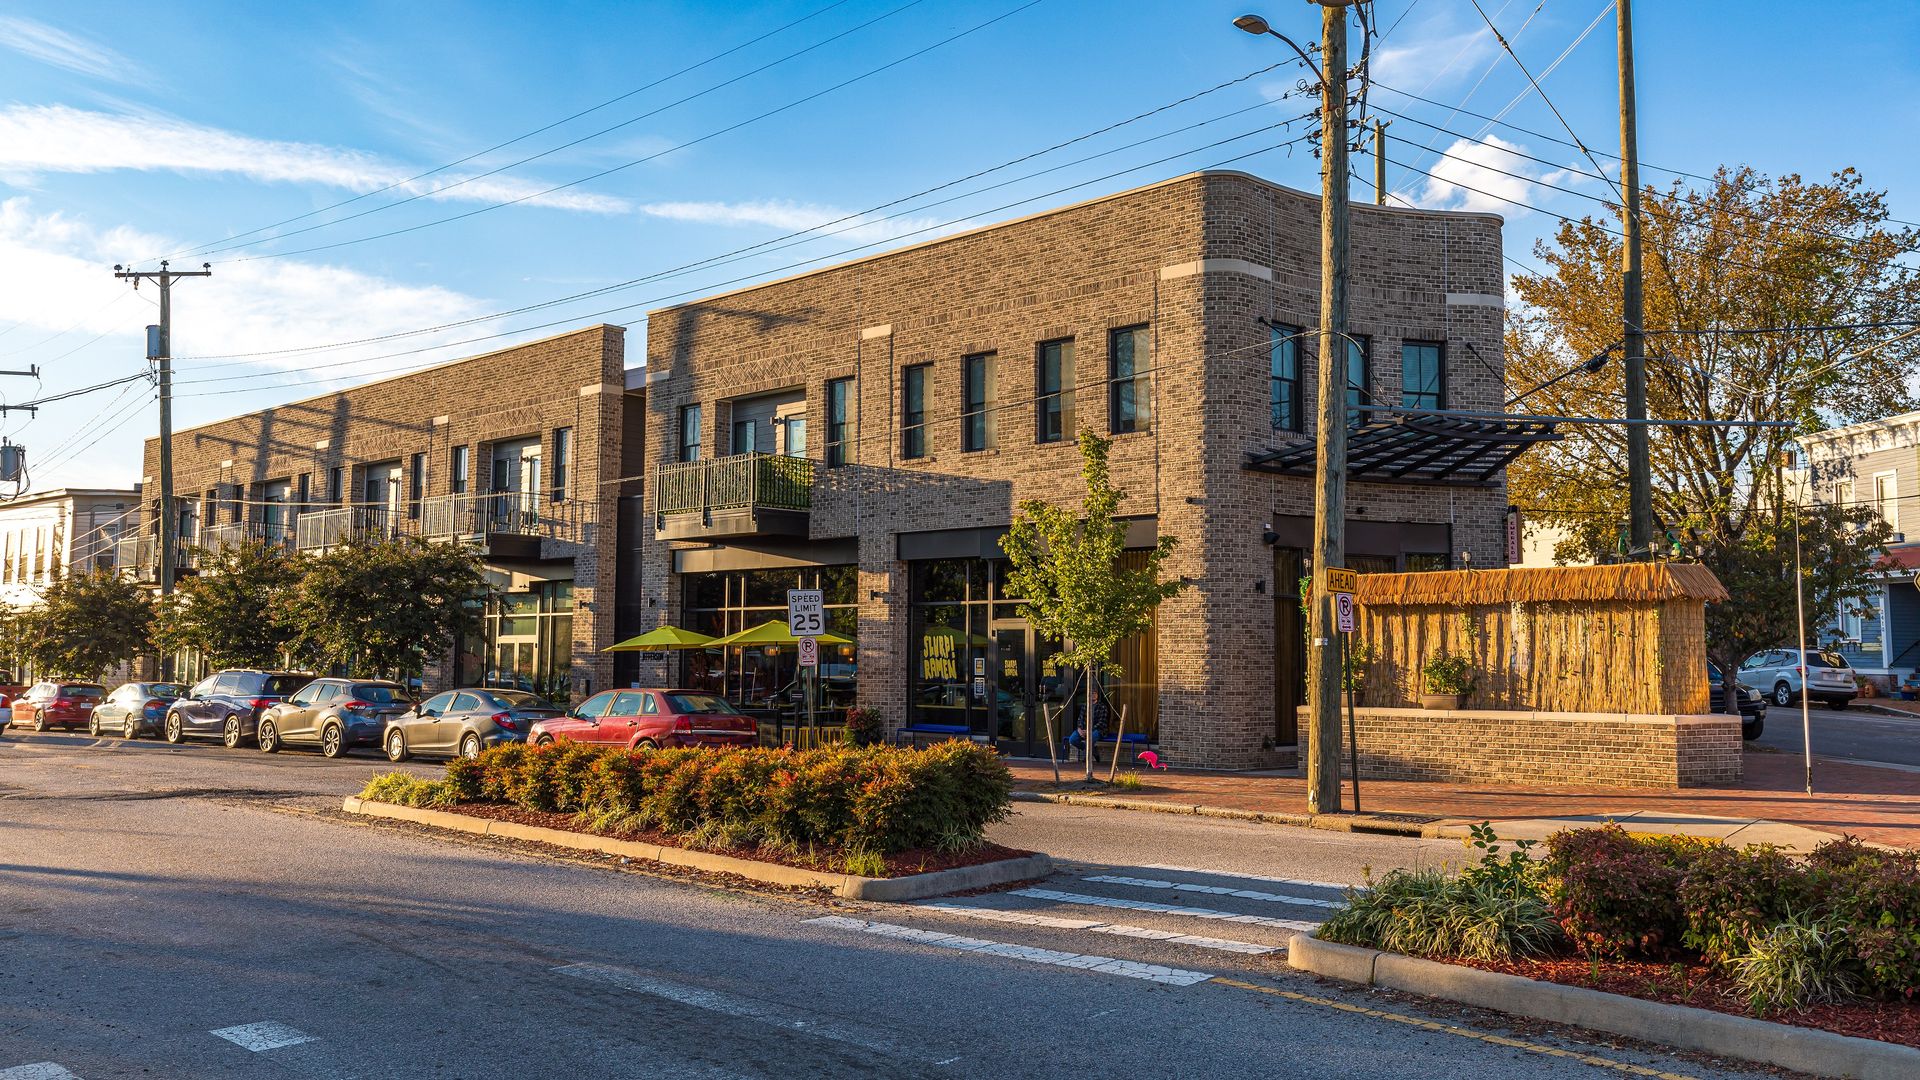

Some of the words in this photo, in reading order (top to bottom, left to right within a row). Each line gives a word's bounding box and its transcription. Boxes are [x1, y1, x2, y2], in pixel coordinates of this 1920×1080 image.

[1329, 573, 1355, 590] AHEAD
[791, 595, 820, 603] SPEED
[795, 604, 817, 613] LIMIT
[793, 614, 820, 631] 25
[923, 635, 955, 658] SLURP!
[924, 657, 957, 680] RAMEN
